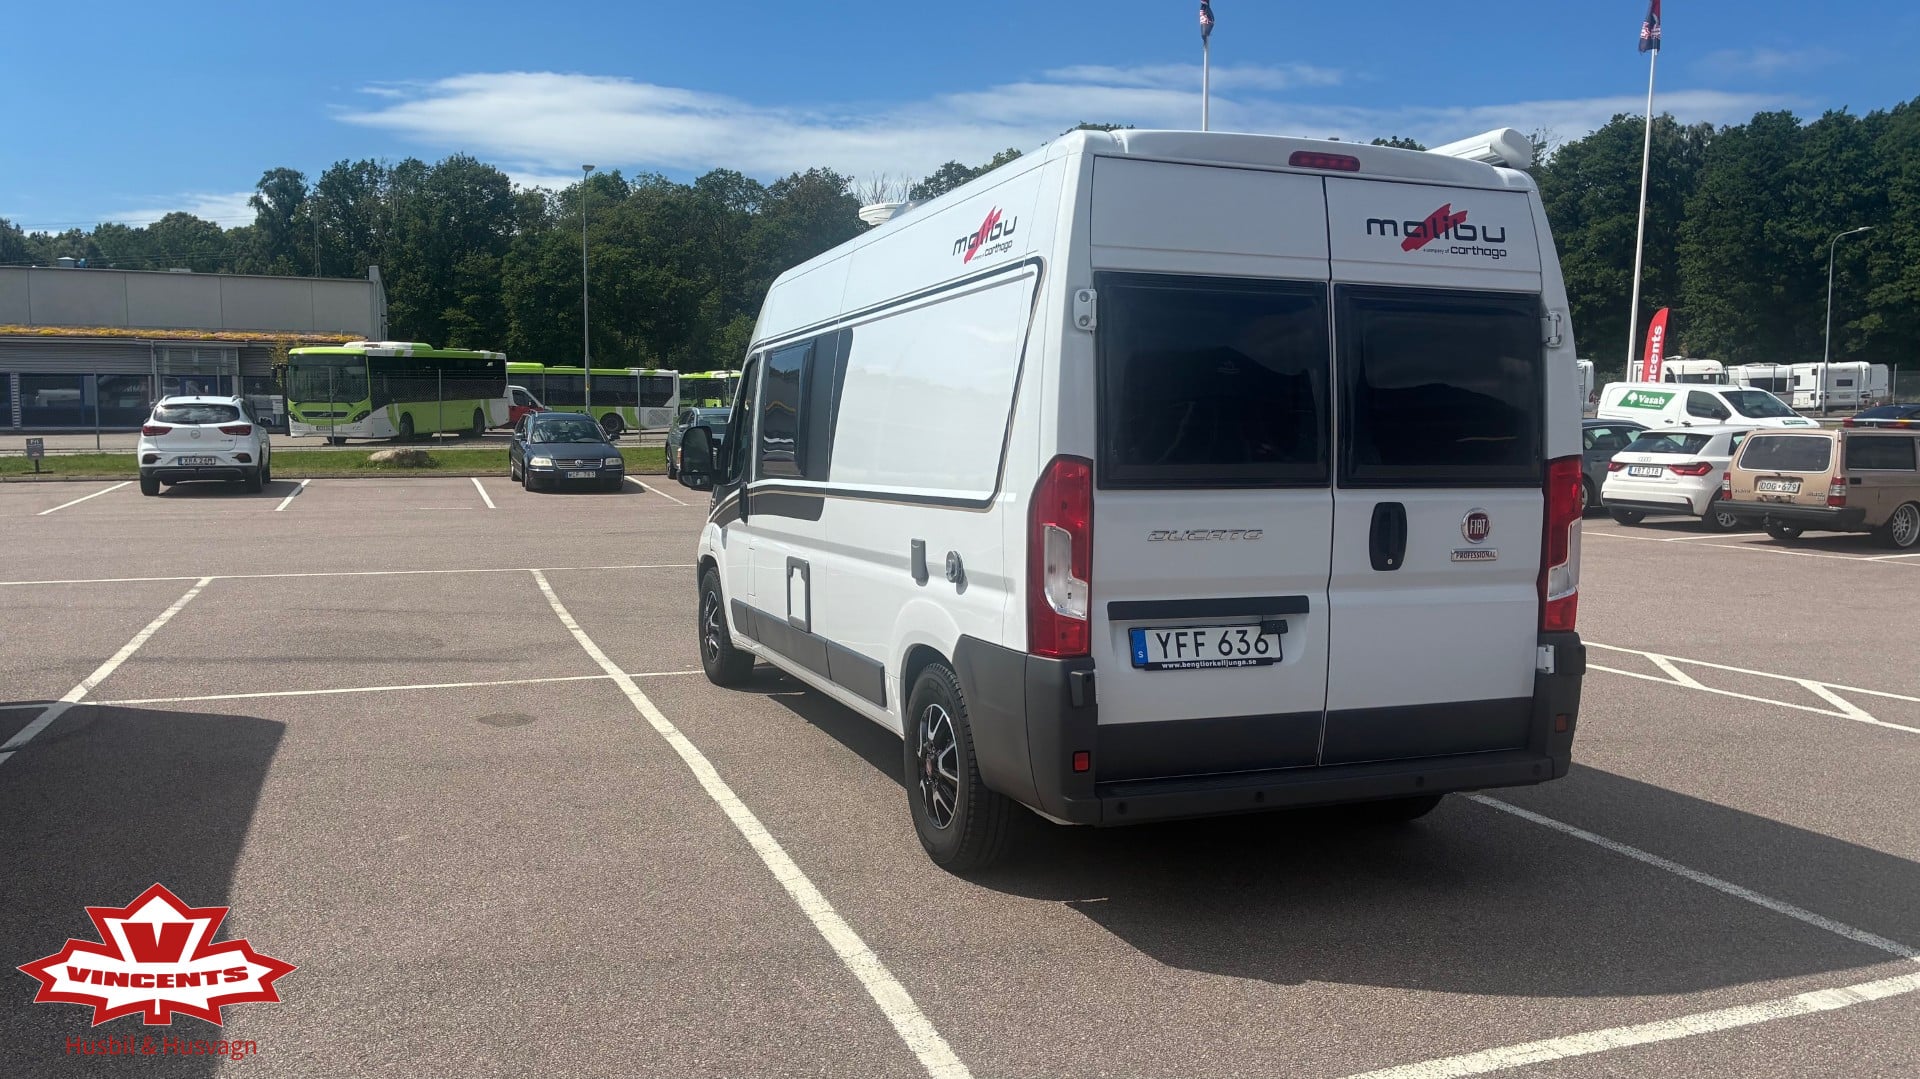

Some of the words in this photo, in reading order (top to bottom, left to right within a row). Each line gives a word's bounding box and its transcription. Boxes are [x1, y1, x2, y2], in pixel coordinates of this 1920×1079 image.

[952, 215, 1018, 256] malibu
[1366, 215, 1506, 243] malibu
[1451, 246, 1507, 259] carthago
[1648, 325, 1662, 384] ncents
[1639, 394, 1665, 405] Vasab
[1782, 483, 1797, 491] 679
[1470, 519, 1487, 535] FIAT
[1147, 529, 1263, 541] DUCATO
[1455, 551, 1496, 559] PROFESSIONAL
[1155, 630, 1206, 659] YFF
[1218, 629, 1269, 656] 636
